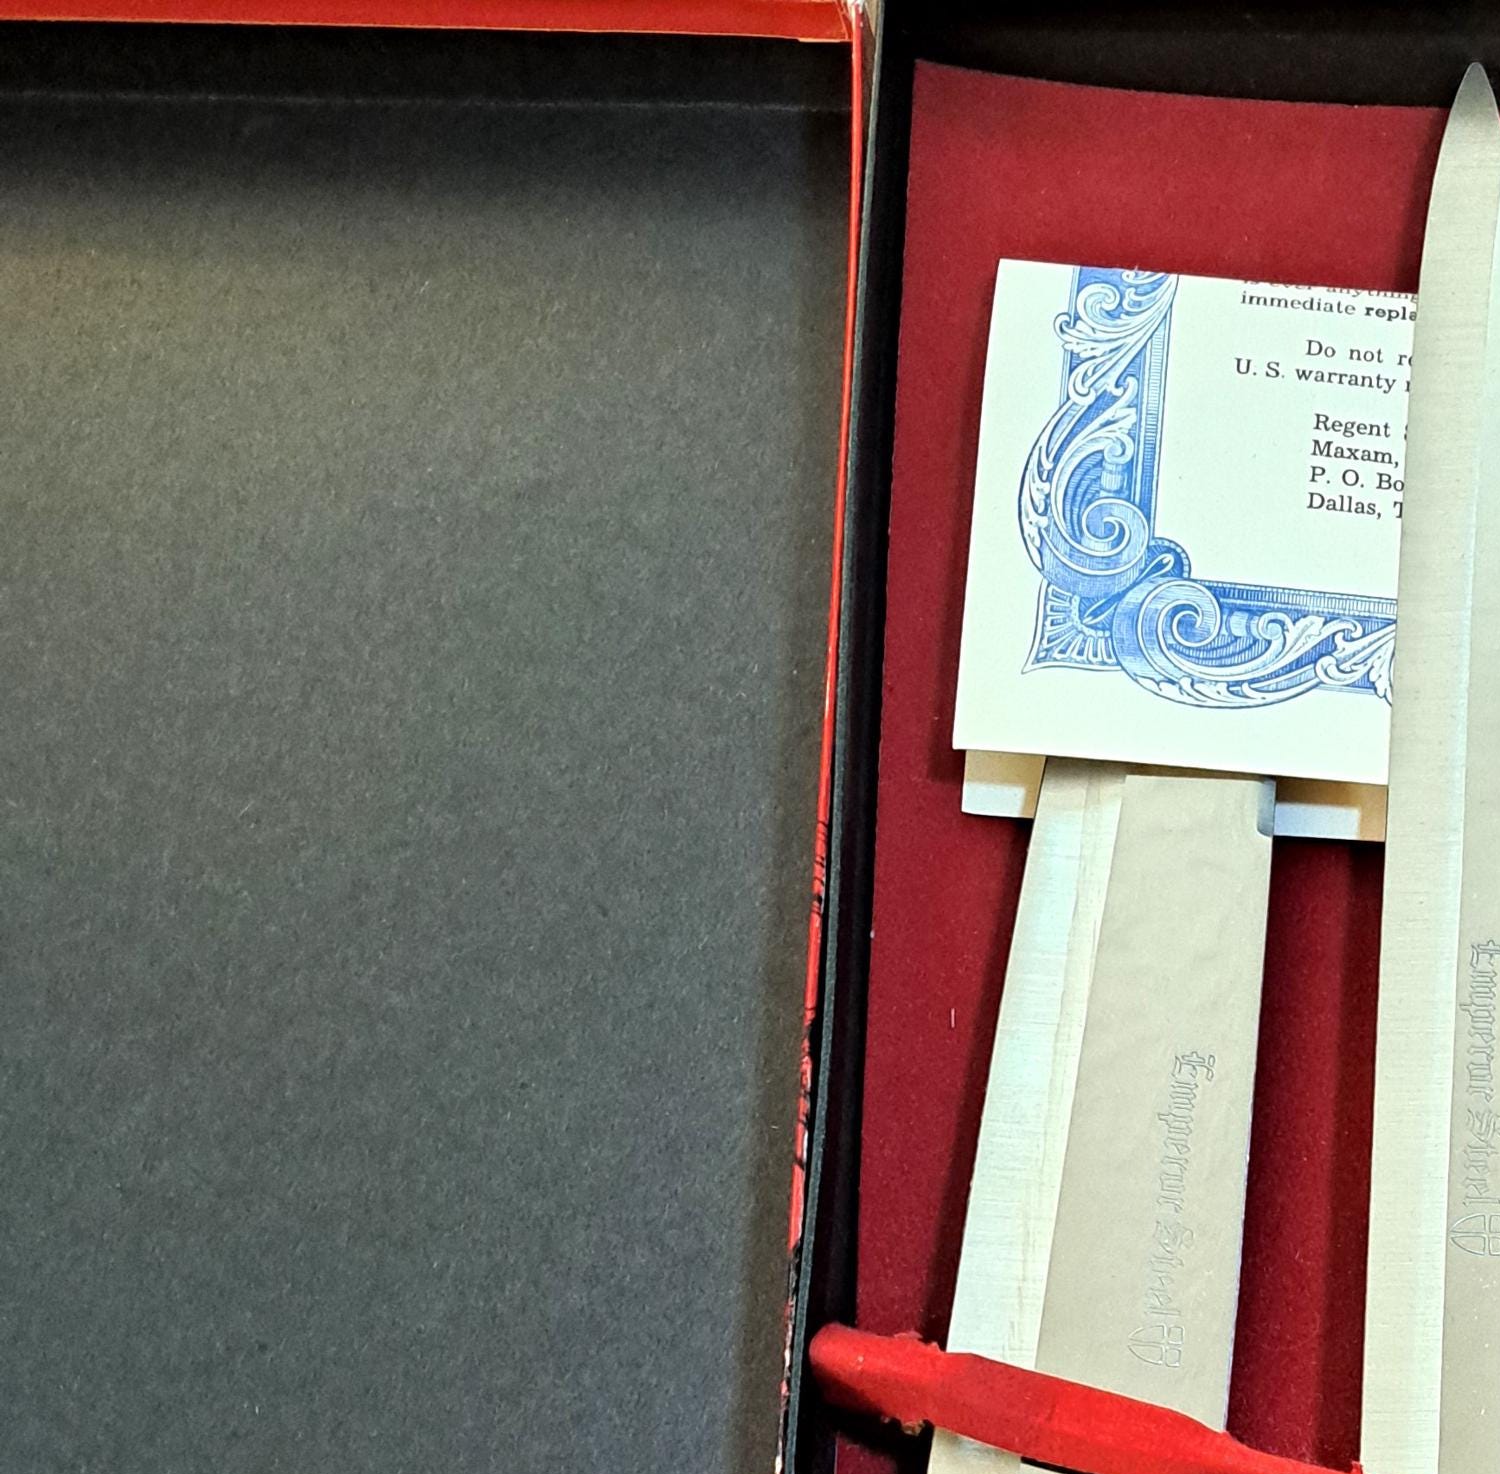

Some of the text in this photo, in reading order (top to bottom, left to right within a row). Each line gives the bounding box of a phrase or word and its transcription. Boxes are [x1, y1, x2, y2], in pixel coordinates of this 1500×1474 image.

[1240, 291, 1356, 316] immediate
[1306, 339, 1336, 358] Do
[1349, 347, 1384, 363] not
[1235, 357, 1257, 376] U.
[1265, 361, 1285, 379] S.
[1295, 367, 1396, 394] warranty
[1313, 413, 1391, 438] Regent
[1310, 439, 1399, 468] Maxam,
[1309, 466, 1330, 485] P.
[1341, 469, 1365, 488] O.
[1307, 492, 1382, 519] Dallas,
